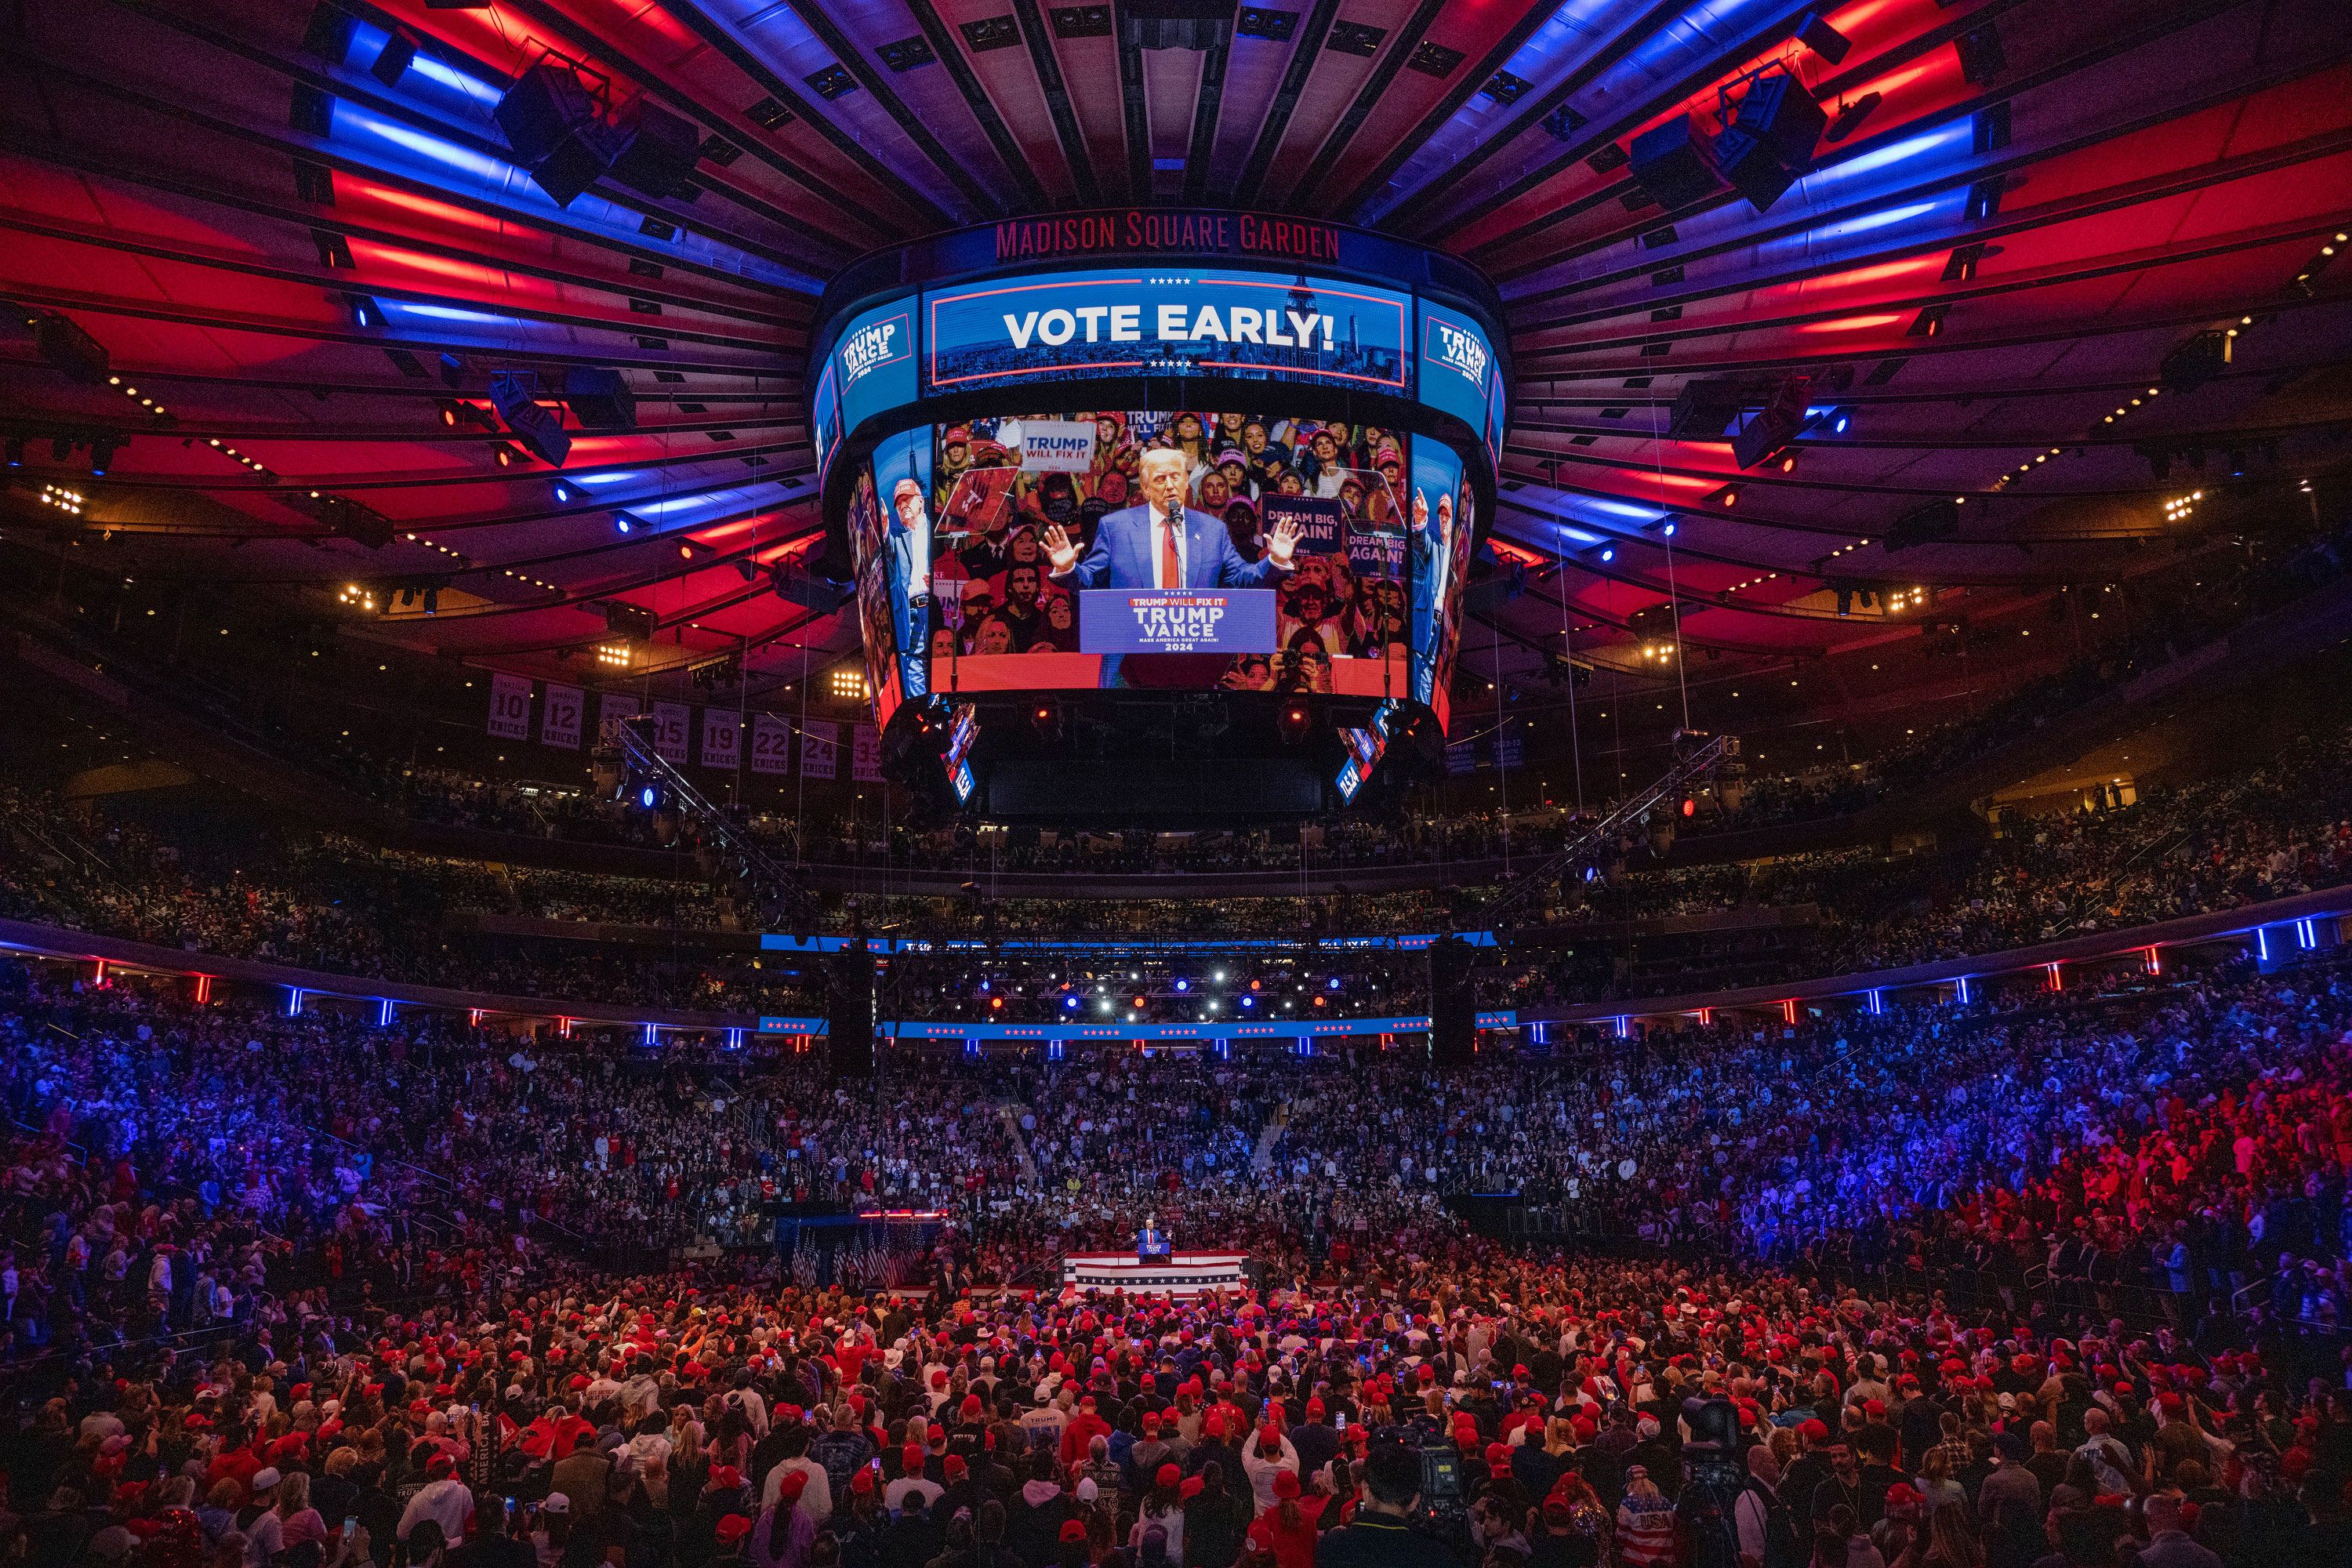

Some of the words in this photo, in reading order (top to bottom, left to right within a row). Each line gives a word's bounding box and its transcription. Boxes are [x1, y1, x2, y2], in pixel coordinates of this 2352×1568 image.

[996, 216, 1115, 260] MADISON
[1127, 211, 1229, 248] SQUARE
[1240, 213, 1340, 260] GARDEN
[1004, 305, 1141, 349] VOTE
[1157, 304, 1334, 350] EARLY!
[844, 324, 895, 361] TRUMP
[1440, 326, 1486, 366] TRUMP
[848, 341, 889, 375] VANCE
[1446, 343, 1483, 376] VANCE
[1127, 411, 1174, 424] TRUMP
[1153, 423, 1165, 432] FIX
[1027, 437, 1088, 450] TRUMP
[1056, 450, 1073, 459] FIX
[1315, 514, 1338, 527] BIG,
[1270, 522, 1333, 539] AIN!
[1349, 535, 1384, 546] DREAM
[1133, 608, 1224, 624] TRUMP
[1144, 624, 1214, 637] VANCE
[497, 695, 524, 719] 10
[550, 703, 575, 728] 12
[488, 720, 526, 736] KNICKS
[658, 720, 682, 744] 15
[546, 729, 579, 746] KNICKS
[710, 726, 734, 750] 19
[755, 731, 786, 755] 22
[805, 738, 833, 760] 24
[705, 752, 736, 765] KNICKS
[753, 758, 785, 769] KNICKS
[803, 762, 833, 775] KNICKS
[479, 1432, 489, 1484] AMERICA
[1639, 1513, 1671, 1530] USA
